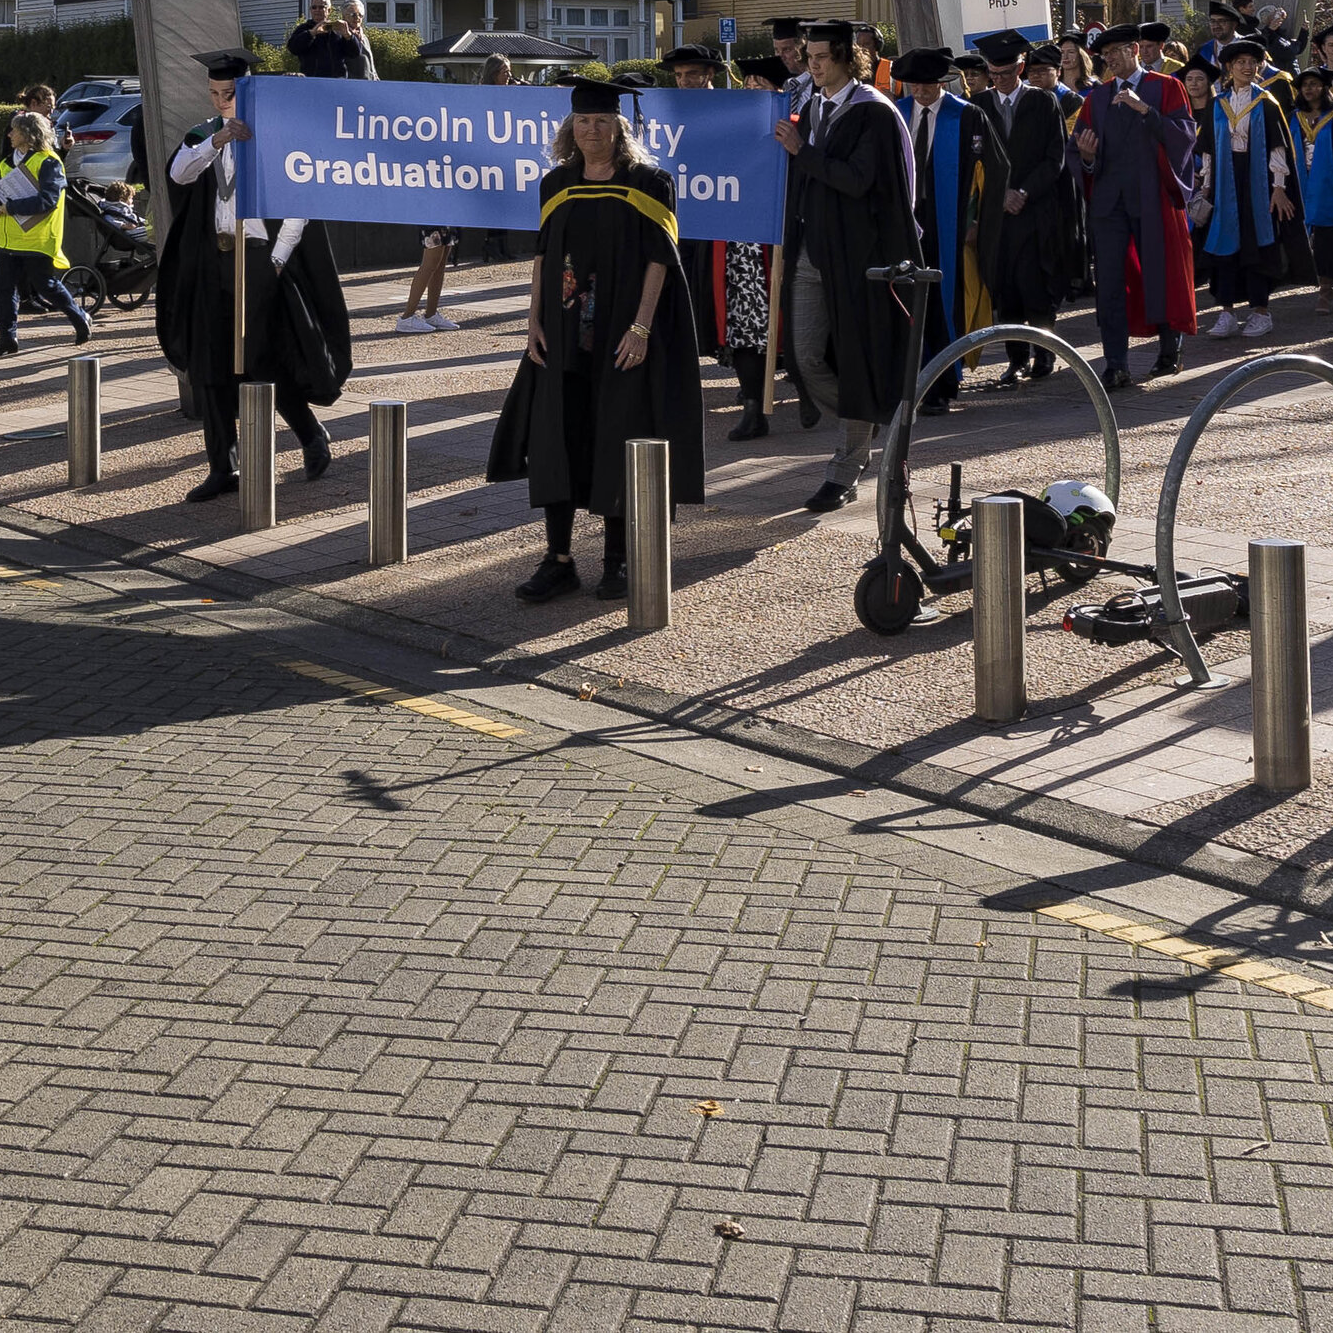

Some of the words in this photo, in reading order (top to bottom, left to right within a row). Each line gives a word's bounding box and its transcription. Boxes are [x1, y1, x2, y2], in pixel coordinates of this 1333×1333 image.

[336, 105, 473, 142] Lincoln
[486, 110, 685, 157] Unity
[284, 151, 504, 190] Graduation
